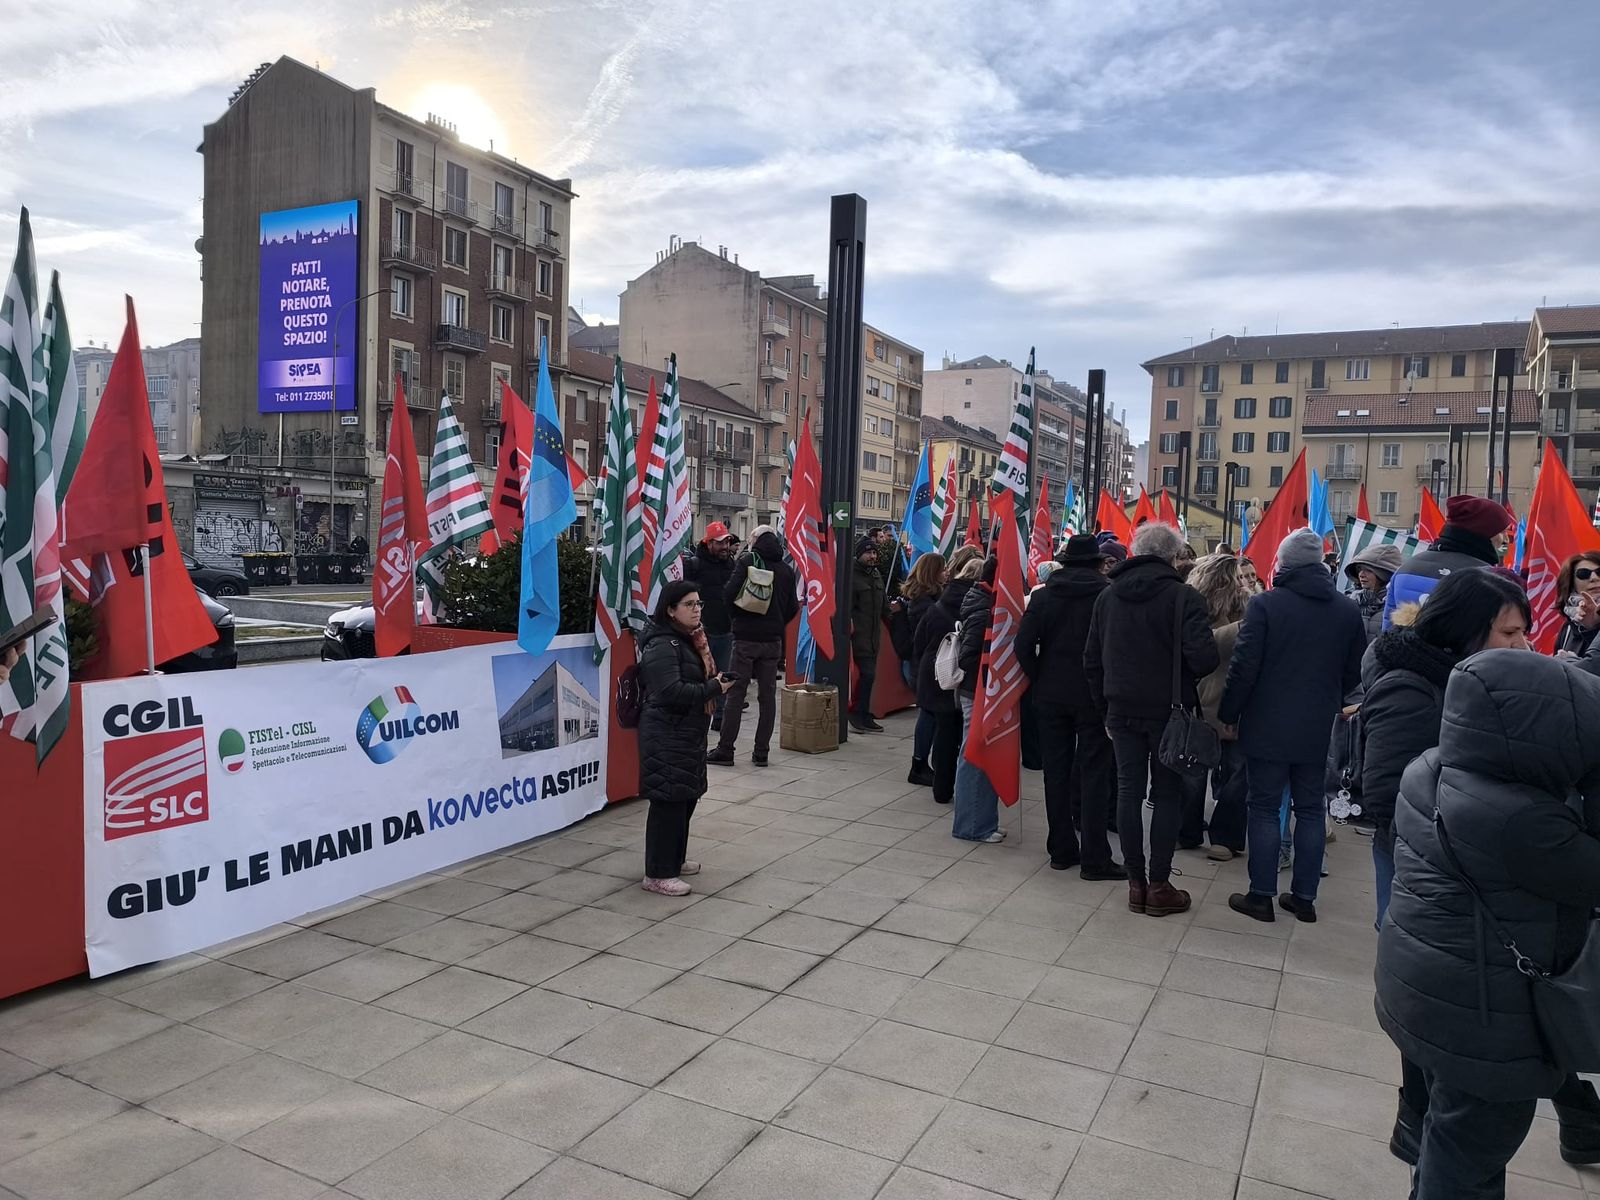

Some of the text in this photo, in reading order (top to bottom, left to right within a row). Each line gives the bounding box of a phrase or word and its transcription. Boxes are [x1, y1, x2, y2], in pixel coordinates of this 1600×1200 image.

[291, 260, 321, 276] FATTI
[282, 277, 330, 294] NOTARE,
[280, 294, 332, 312] PRENOTA
[283, 312, 328, 331] QUESTO
[283, 331, 327, 346] SPAZIO!
[275, 392, 289, 402] Tel:
[290, 391, 303, 402] 011
[102, 695, 204, 738] CGIL
[378, 710, 460, 742] UILCOM
[248, 727, 284, 745] FISTel
[291, 721, 317, 738] CISL
[251, 735, 331, 757] Federazione Informazione
[252, 756, 286, 771] Spettacolo
[290, 744, 348, 762] Telecomunicazioni
[149, 791, 203, 824] SLC
[224, 850, 270, 893] LE
[281, 821, 374, 877] MANI
[382, 809, 425, 846] DA
[540, 760, 600, 800] ASTI!!!
